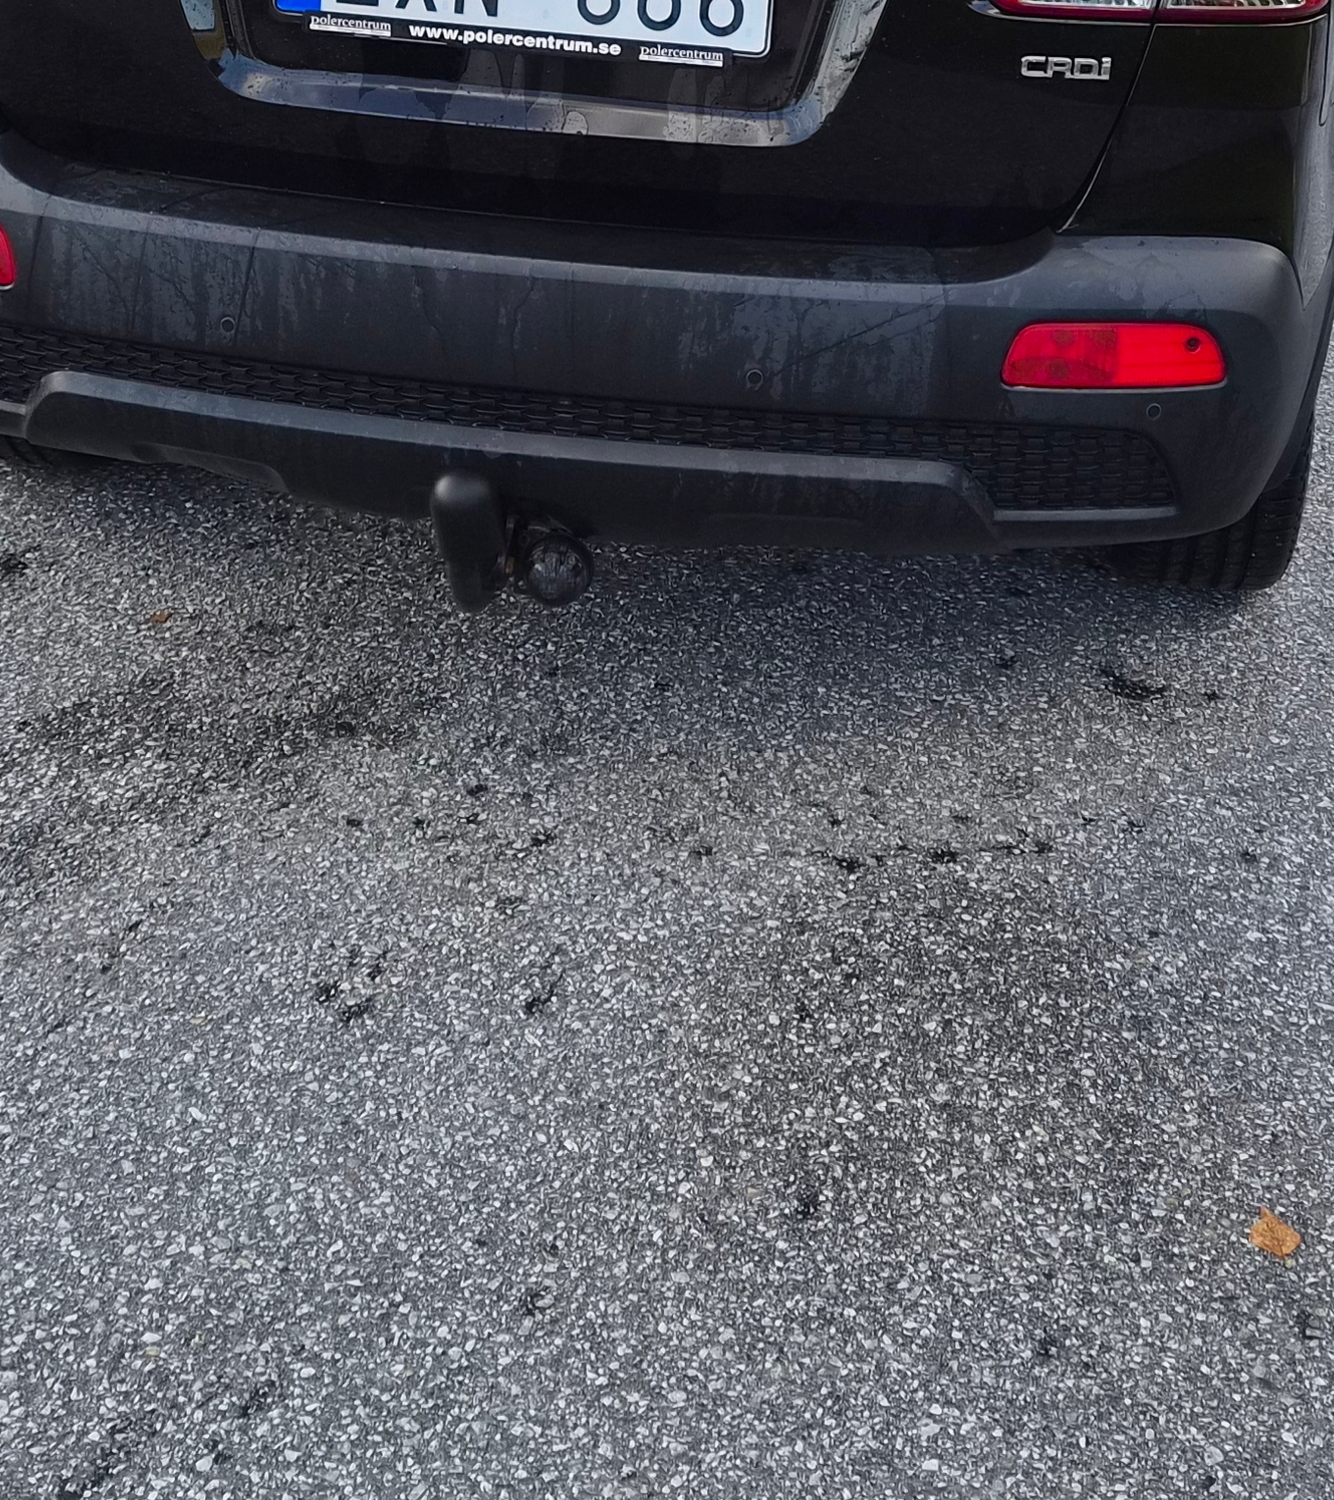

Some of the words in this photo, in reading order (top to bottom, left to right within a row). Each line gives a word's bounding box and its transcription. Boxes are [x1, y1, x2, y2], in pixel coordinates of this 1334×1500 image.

[310, 14, 392, 31] polercentrum
[409, 23, 622, 55] www.polercentrum.se
[639, 45, 724, 61] polercentrum
